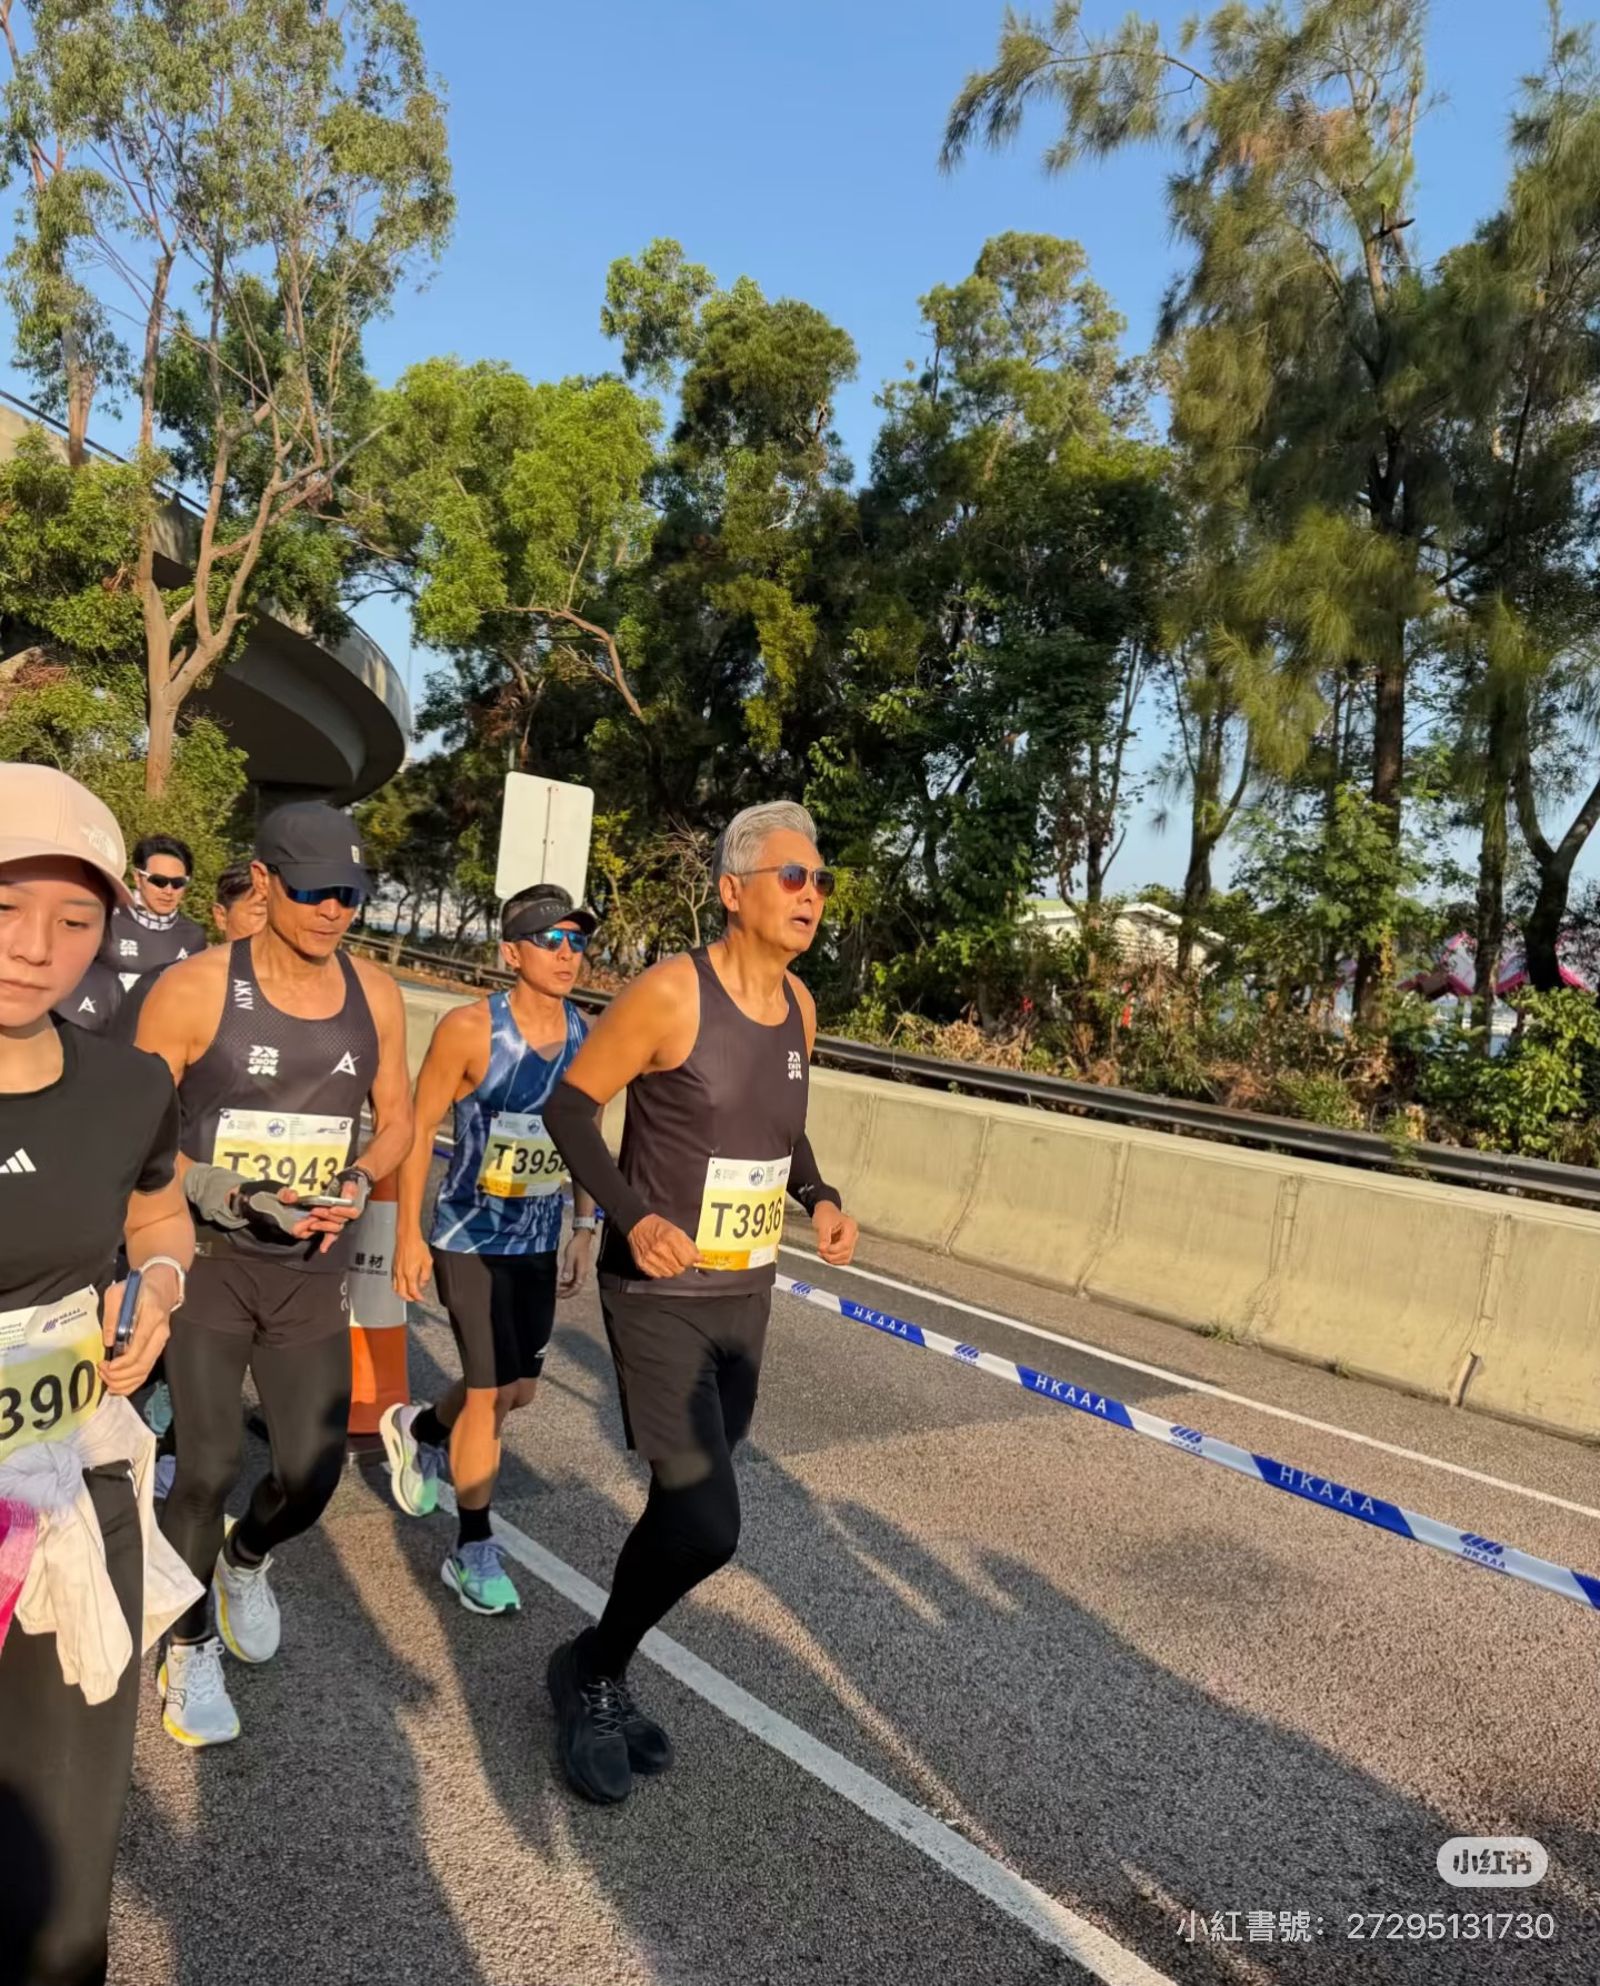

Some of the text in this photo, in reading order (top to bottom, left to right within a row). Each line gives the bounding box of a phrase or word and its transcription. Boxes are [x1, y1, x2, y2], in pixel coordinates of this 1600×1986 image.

[233, 979, 254, 1011] AKIV
[223, 1152, 339, 1191] T3943
[711, 1197, 782, 1239] T3936
[853, 1306, 908, 1336] HKAAA
[1034, 1374, 1107, 1414] HKAAA
[1279, 1466, 1376, 1516] HKAAA
[1461, 1547, 1507, 1569] HKAAA
